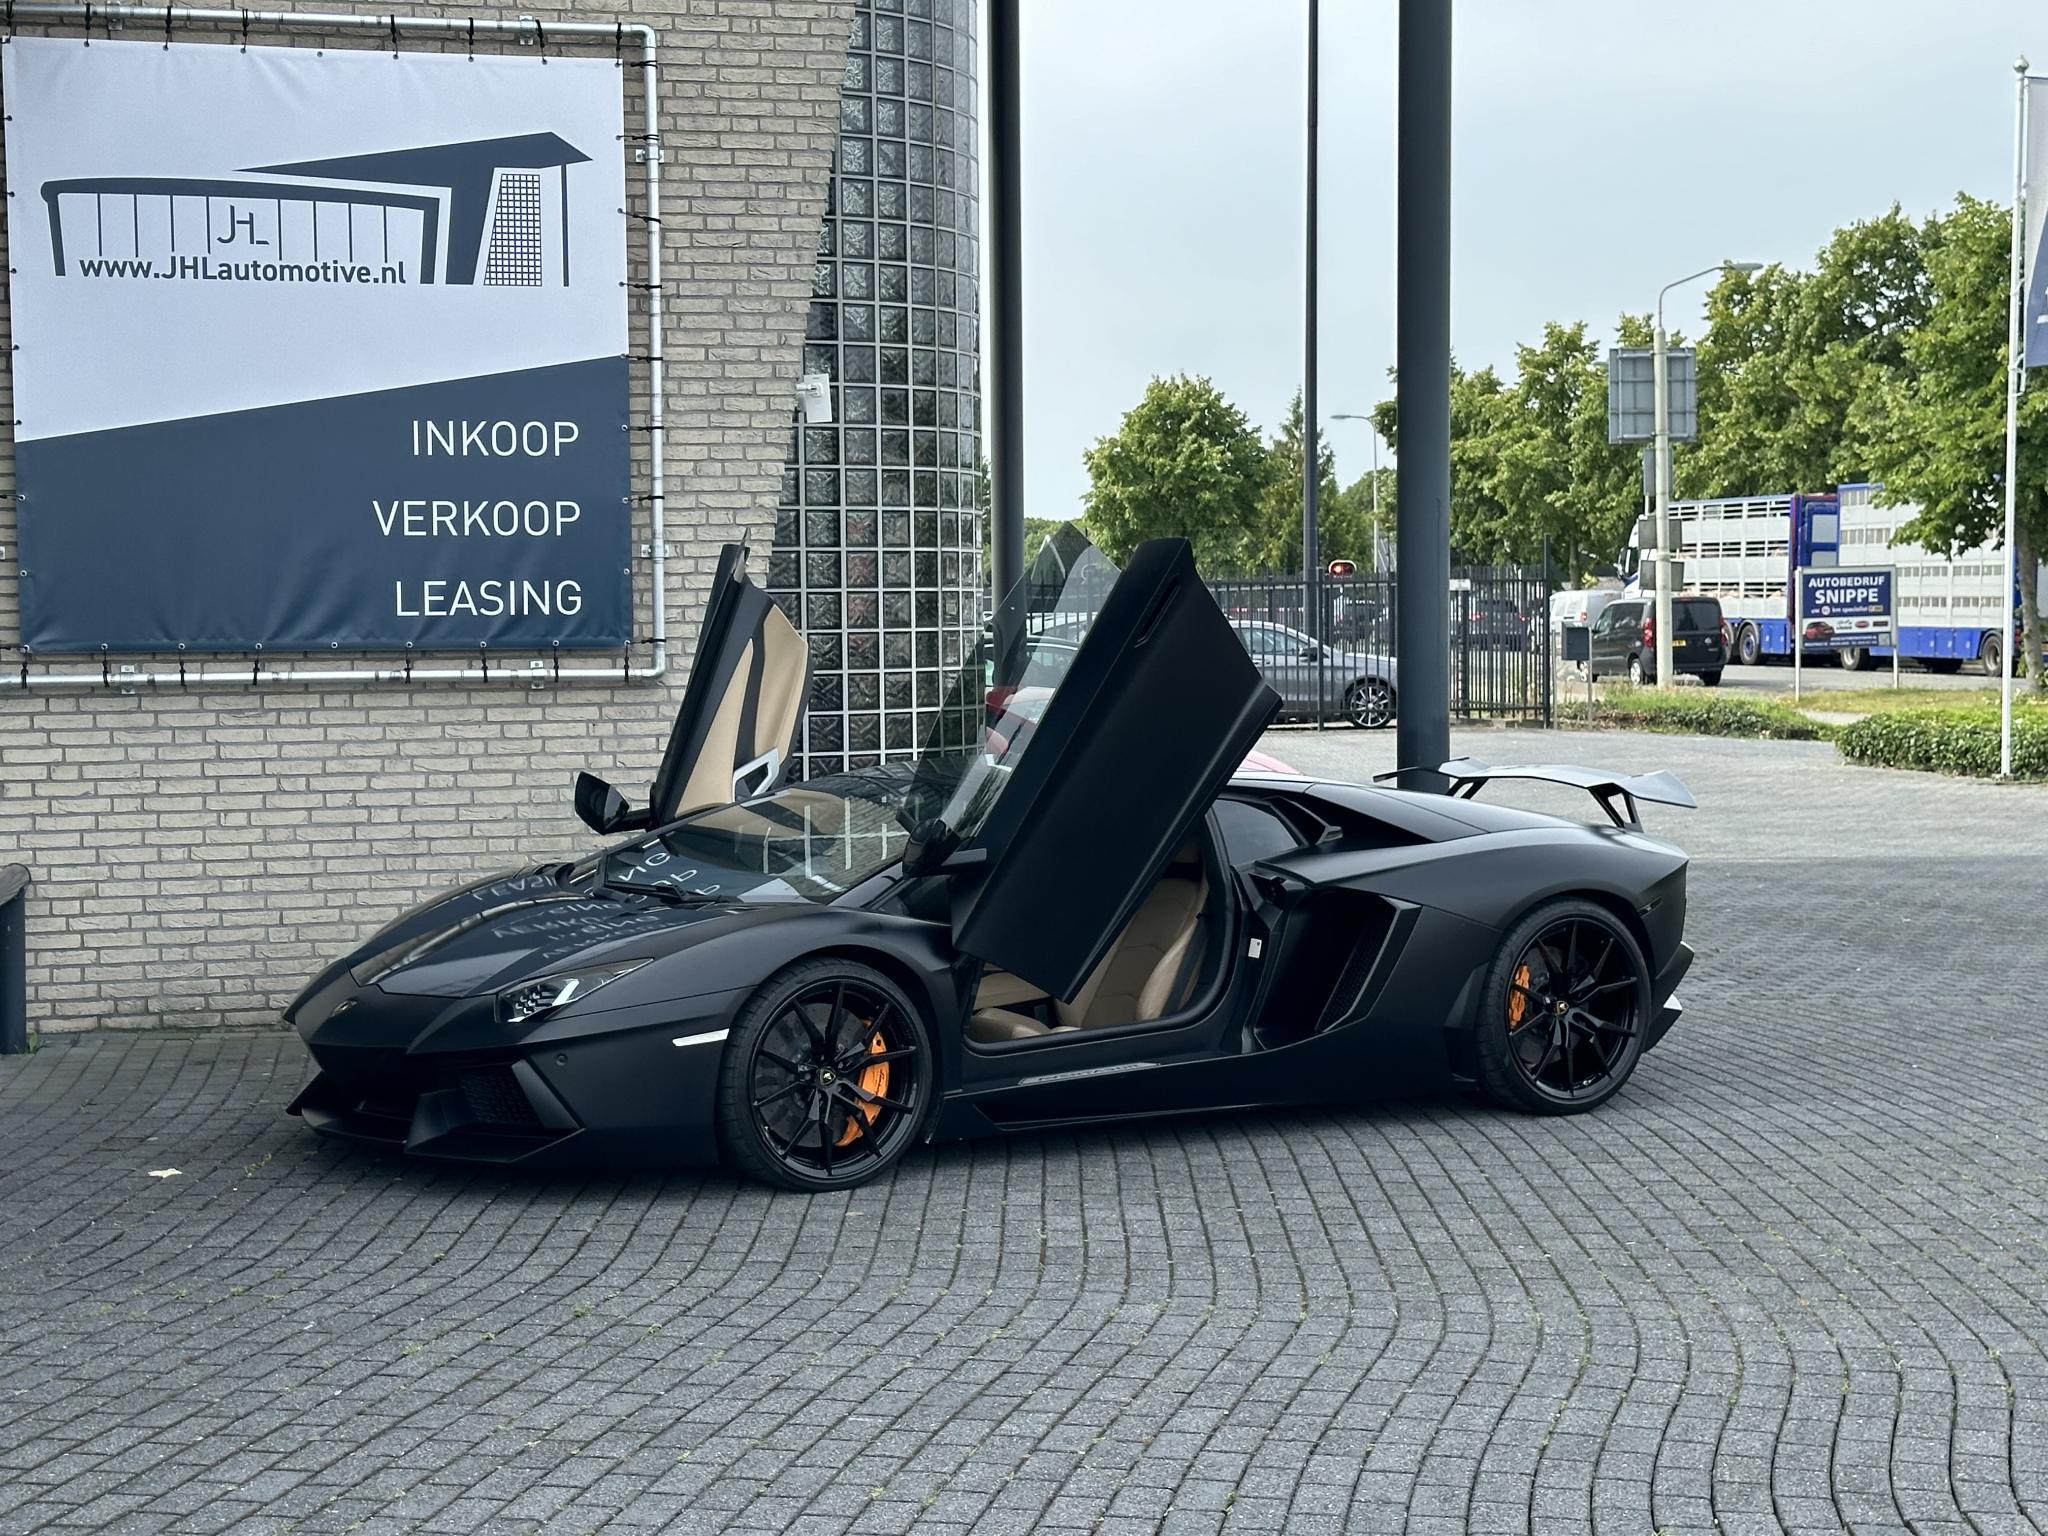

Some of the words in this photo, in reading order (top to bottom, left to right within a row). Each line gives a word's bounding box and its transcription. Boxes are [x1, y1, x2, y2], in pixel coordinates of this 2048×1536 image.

[216, 204, 270, 245] JHL
[79, 255, 406, 284] www.JHLautomotive.nl
[413, 420, 579, 457] INKOOP
[372, 500, 581, 537] VERKOOP
[396, 579, 582, 617] LEASING
[1808, 576, 1885, 588] AUTOBEDRIJF
[1815, 588, 1879, 604] SNIPPE
